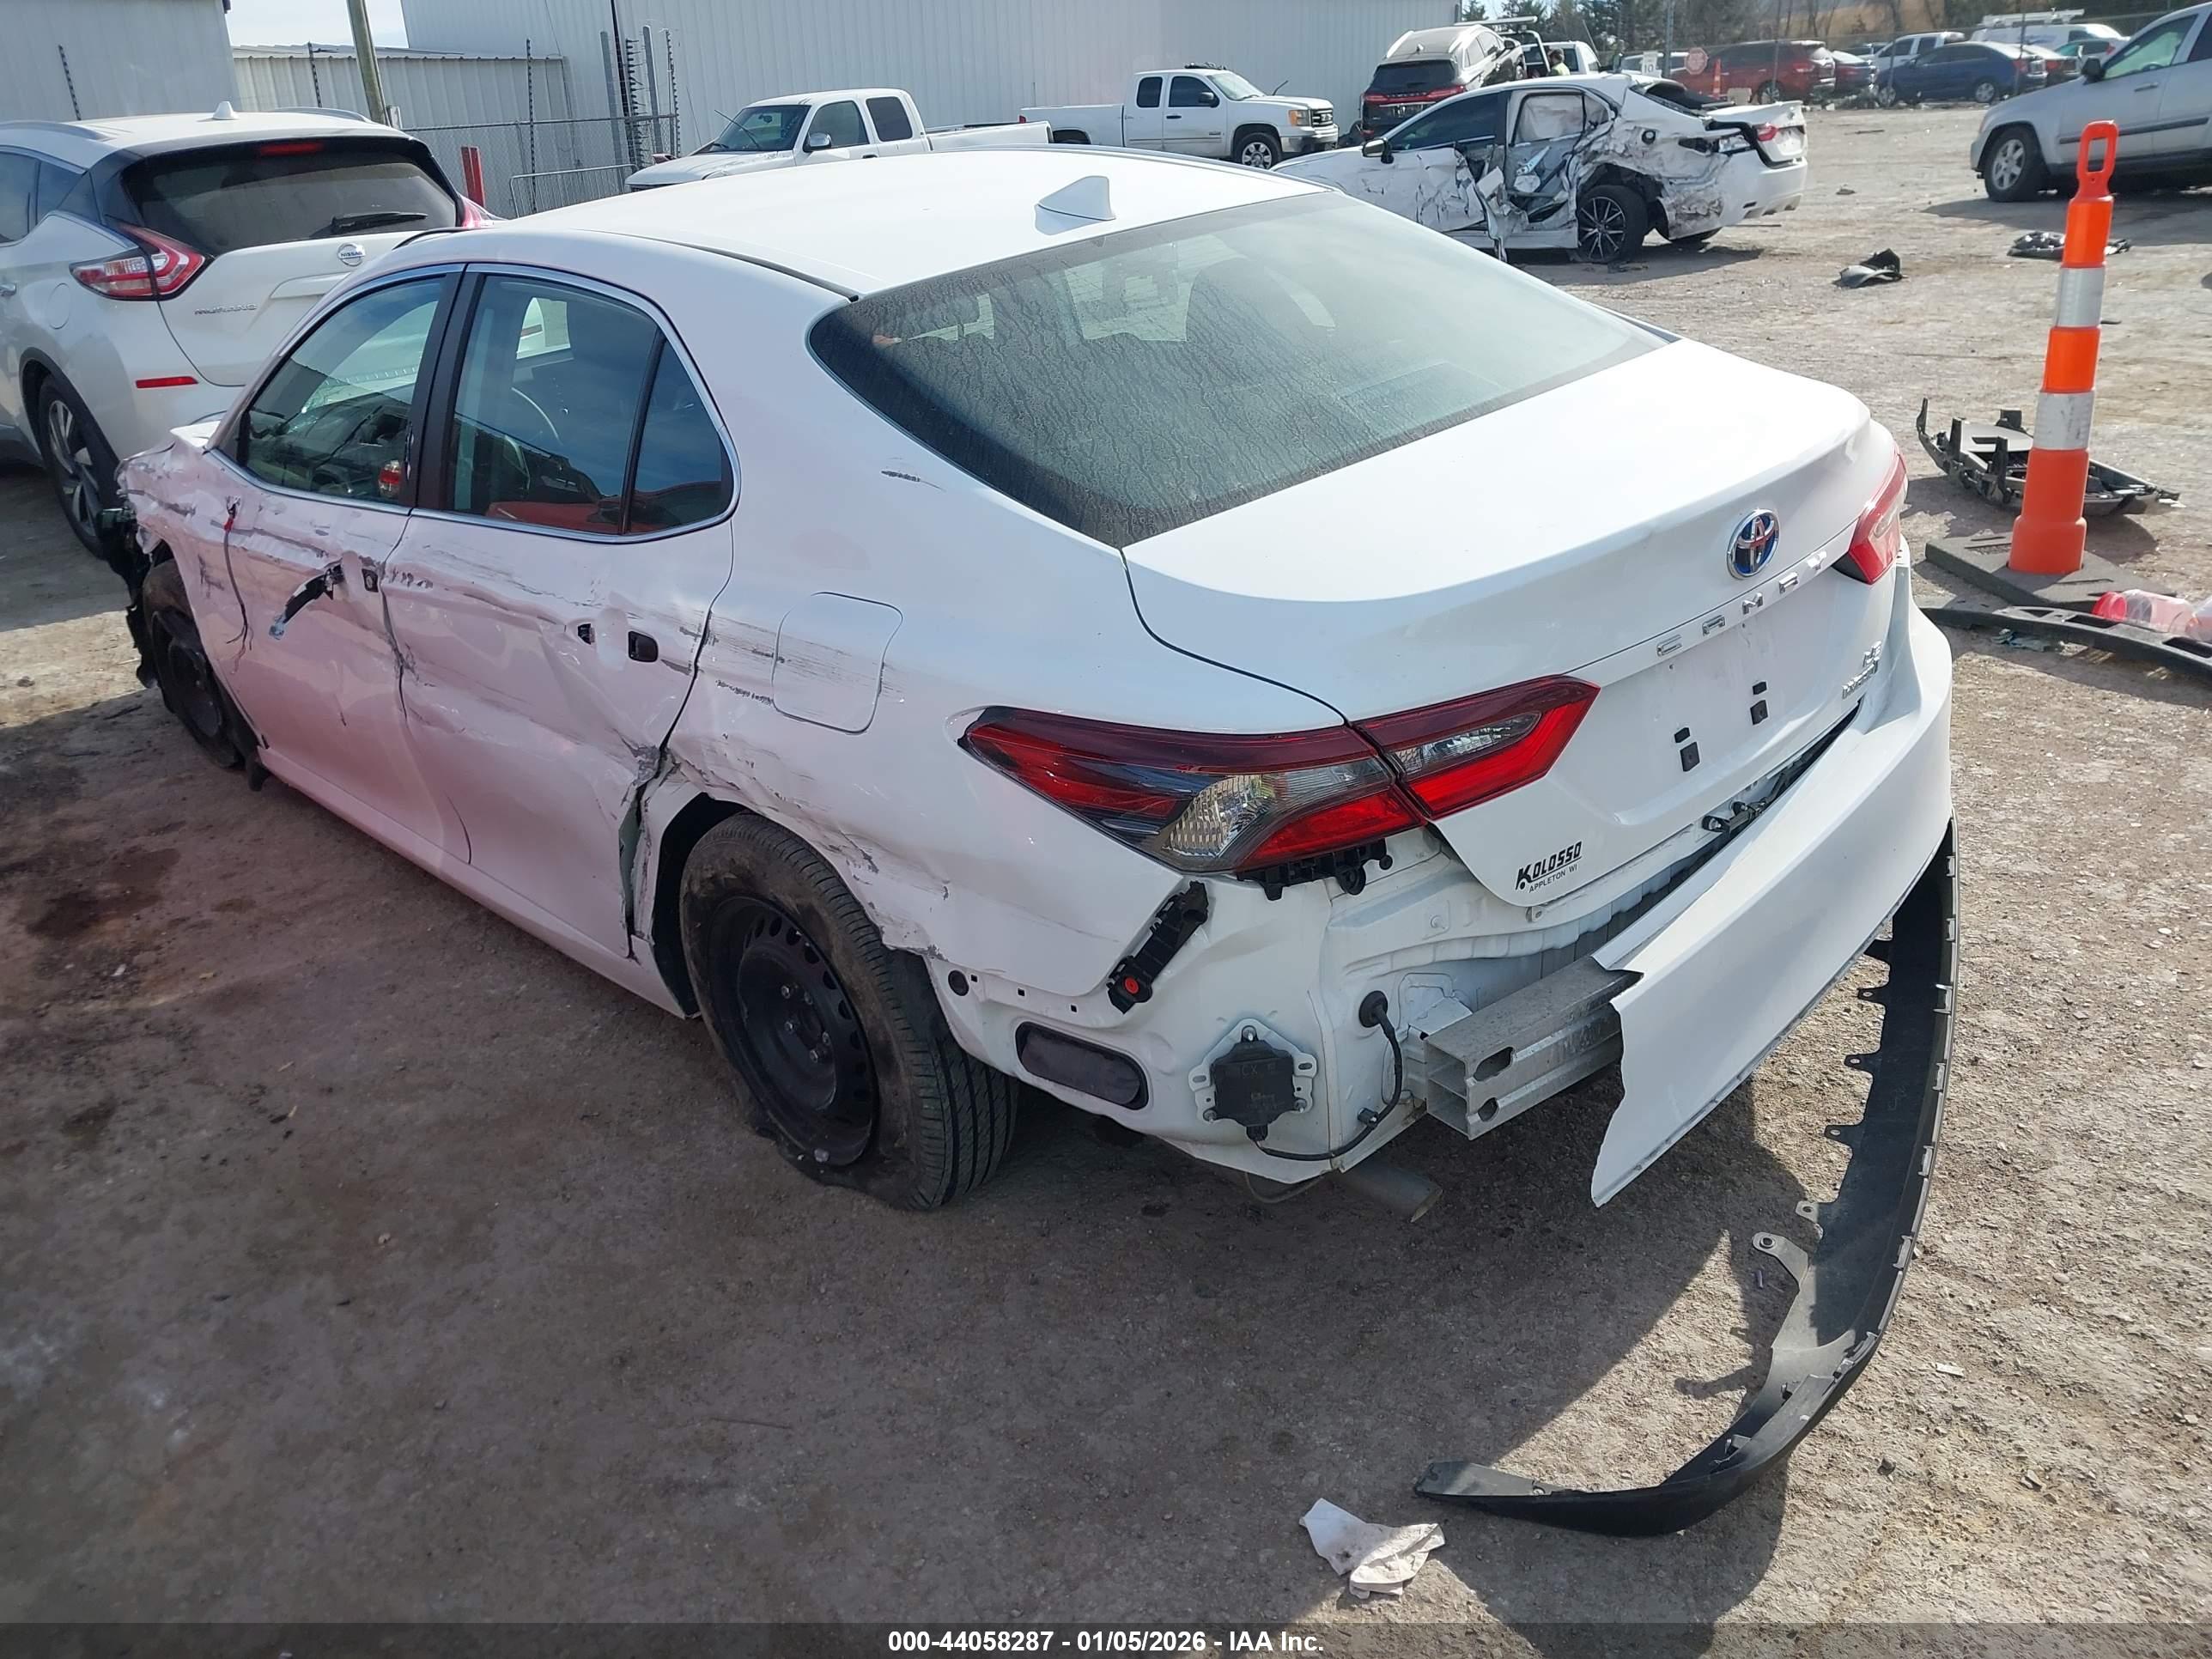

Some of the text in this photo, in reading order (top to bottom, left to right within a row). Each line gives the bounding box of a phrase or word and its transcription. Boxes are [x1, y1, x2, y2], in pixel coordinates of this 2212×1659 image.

[1656, 550, 1827, 658] CAMRY
[1515, 841, 1583, 890] KOLOSSO
[1528, 863, 1577, 894] APPLETON WI
